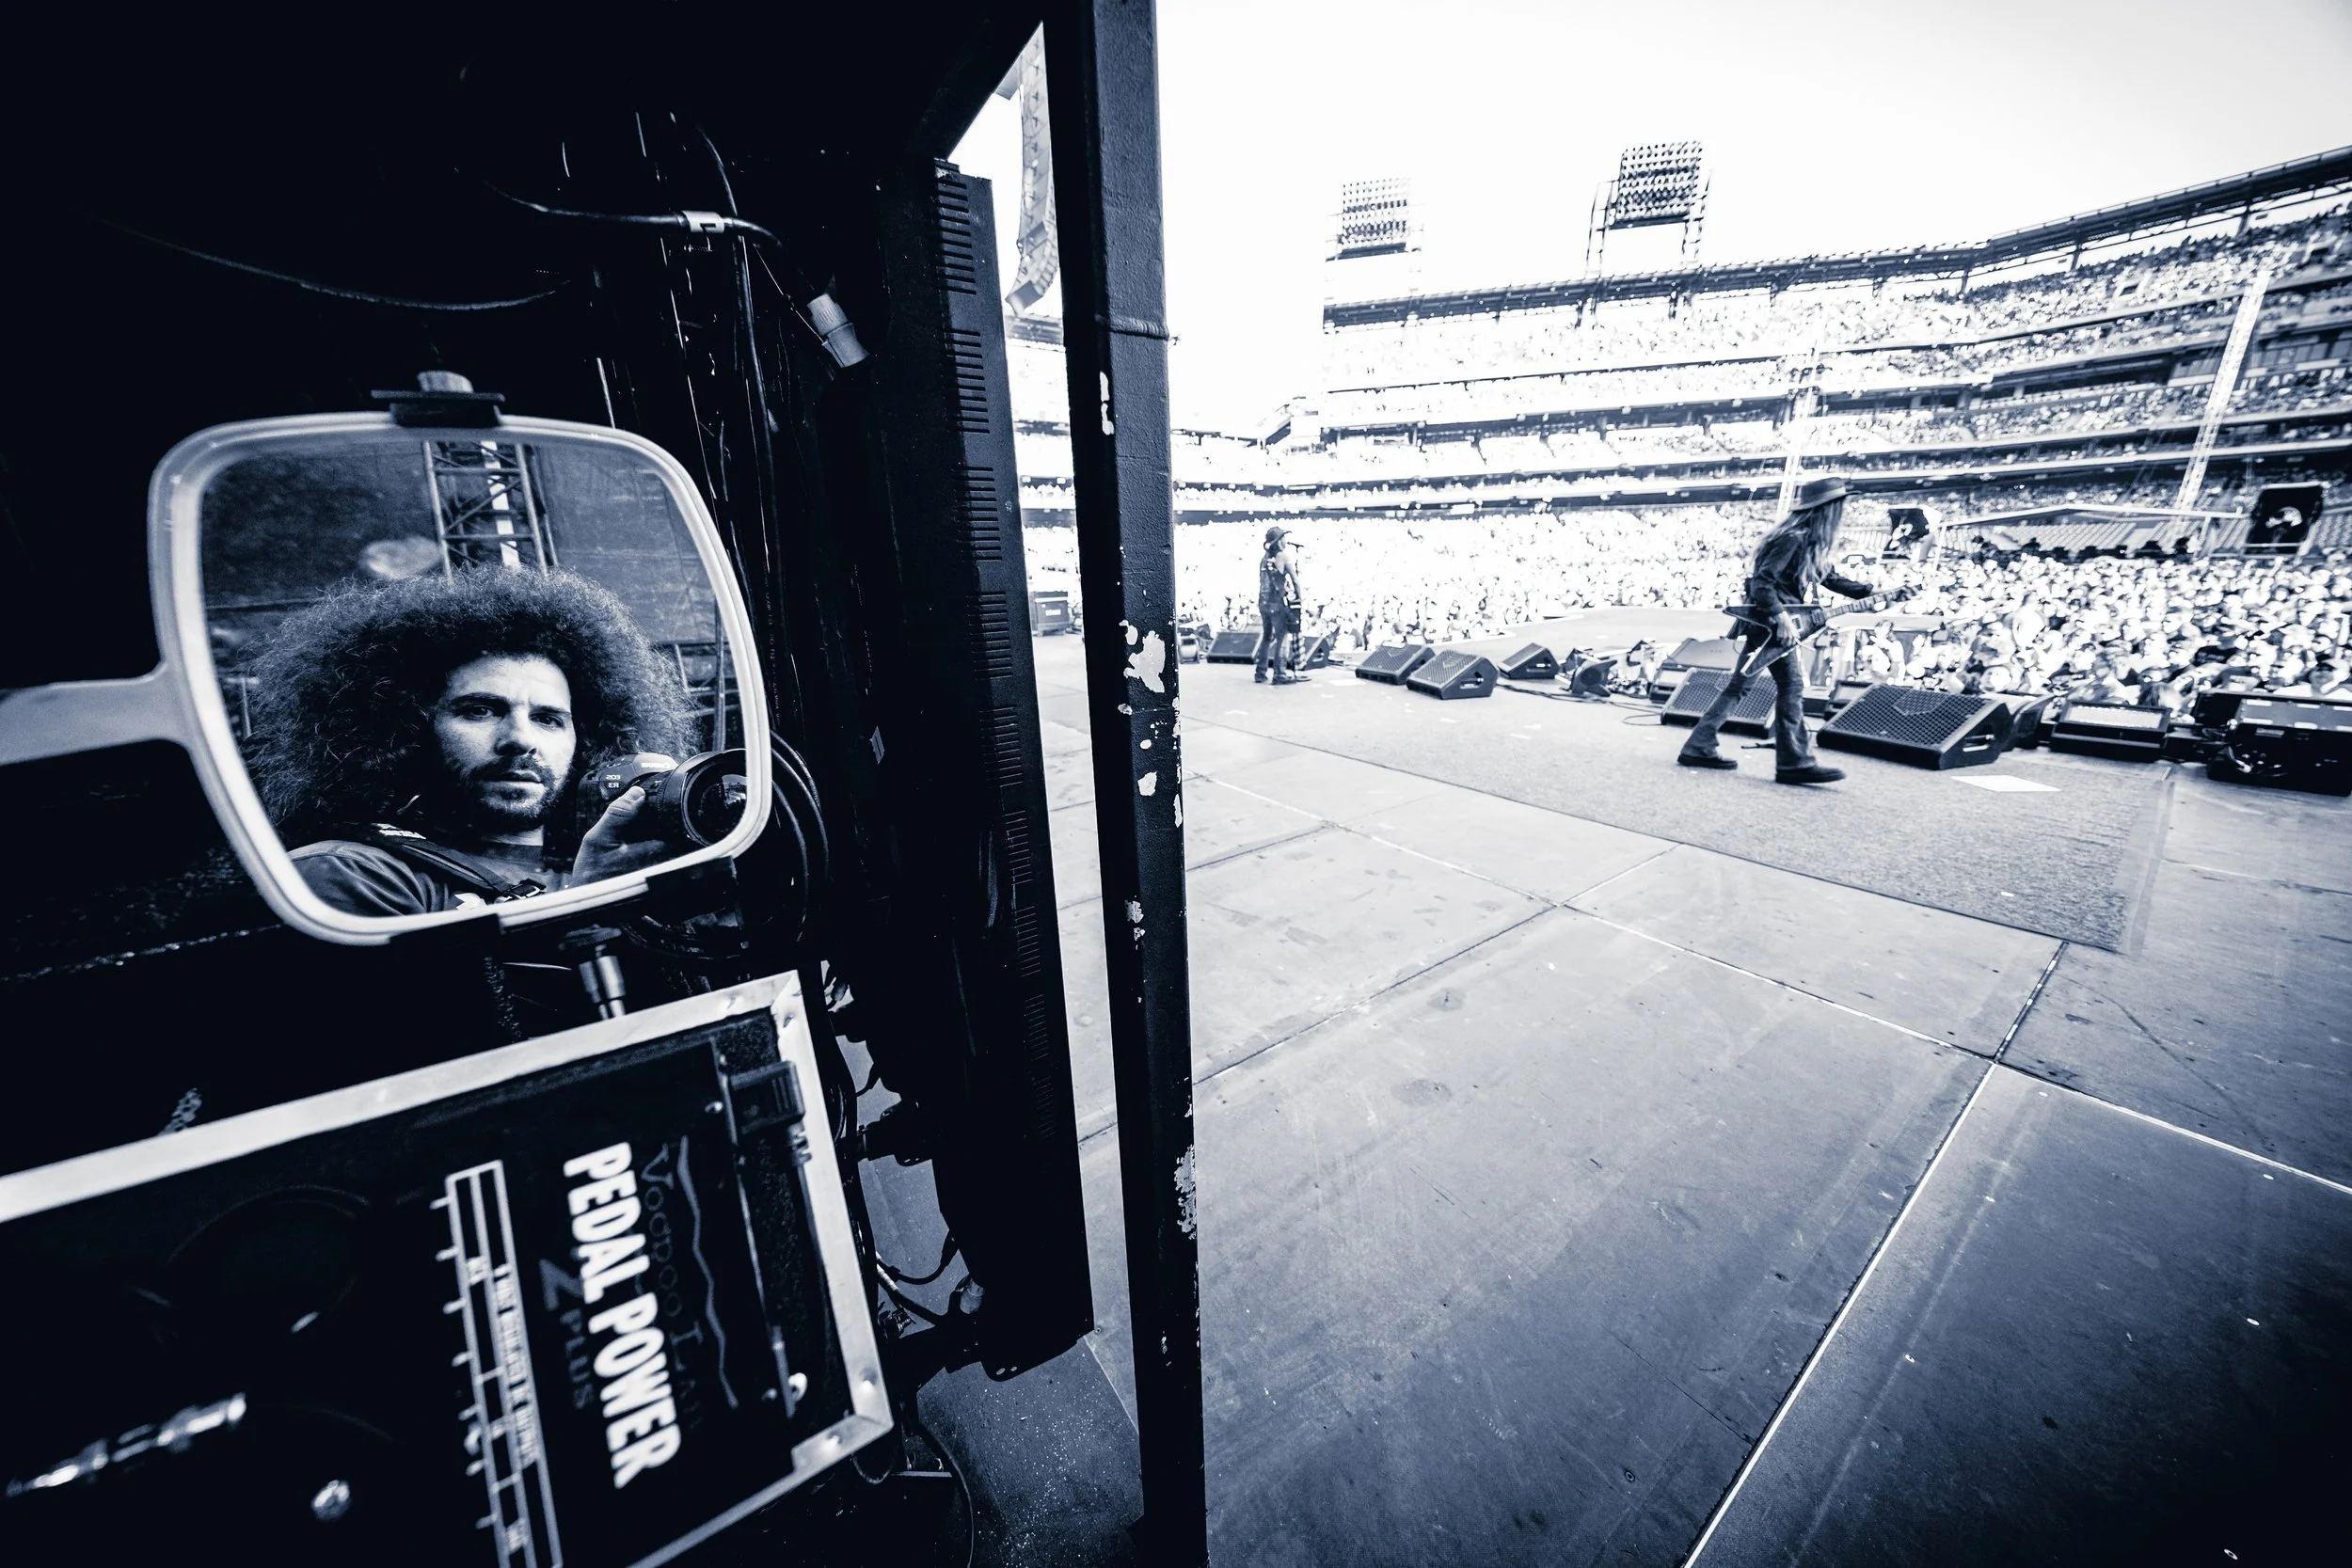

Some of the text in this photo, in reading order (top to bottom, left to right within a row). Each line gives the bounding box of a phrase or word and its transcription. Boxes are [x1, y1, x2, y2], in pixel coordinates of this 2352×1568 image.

[560, 1308, 596, 1410] PLUS
[563, 1141, 682, 1489] PEDAL POWER
